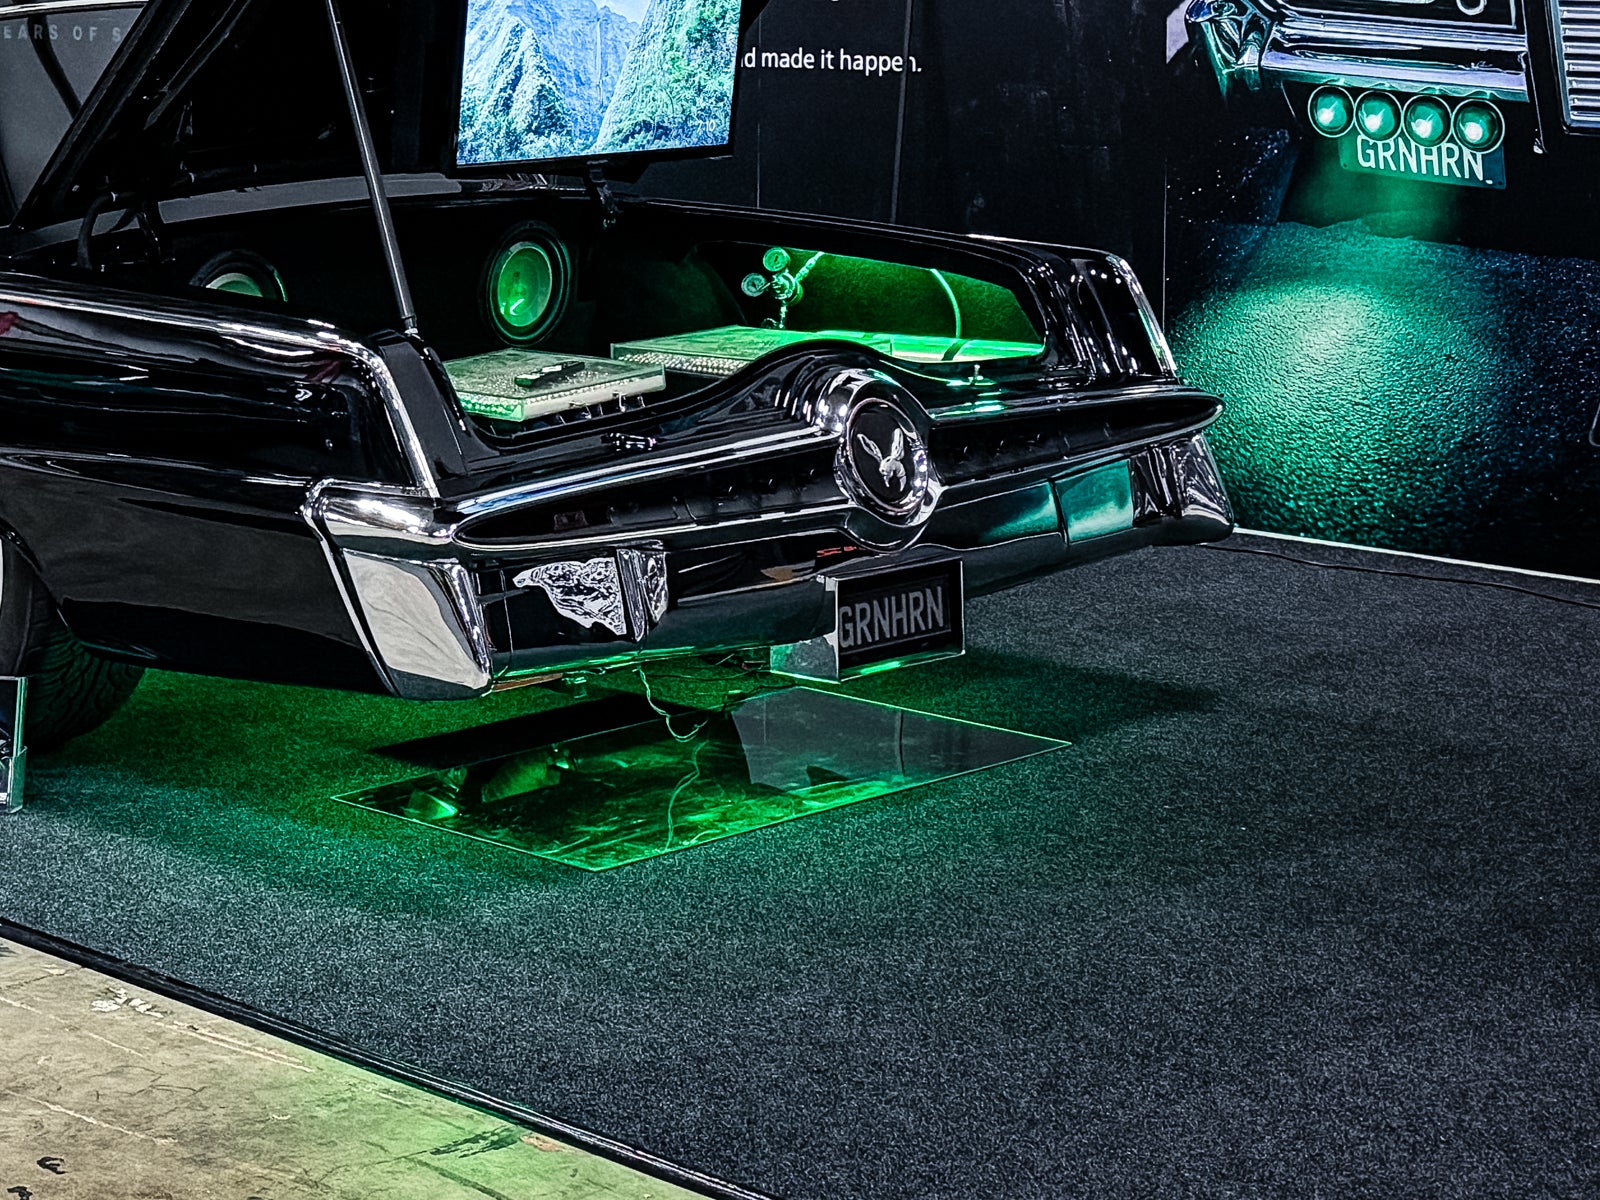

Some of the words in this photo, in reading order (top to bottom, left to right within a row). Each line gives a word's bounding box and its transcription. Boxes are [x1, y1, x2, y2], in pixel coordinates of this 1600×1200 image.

[761, 46, 815, 70] made
[820, 48, 835, 70] it
[838, 585, 944, 649] GRNHRN
